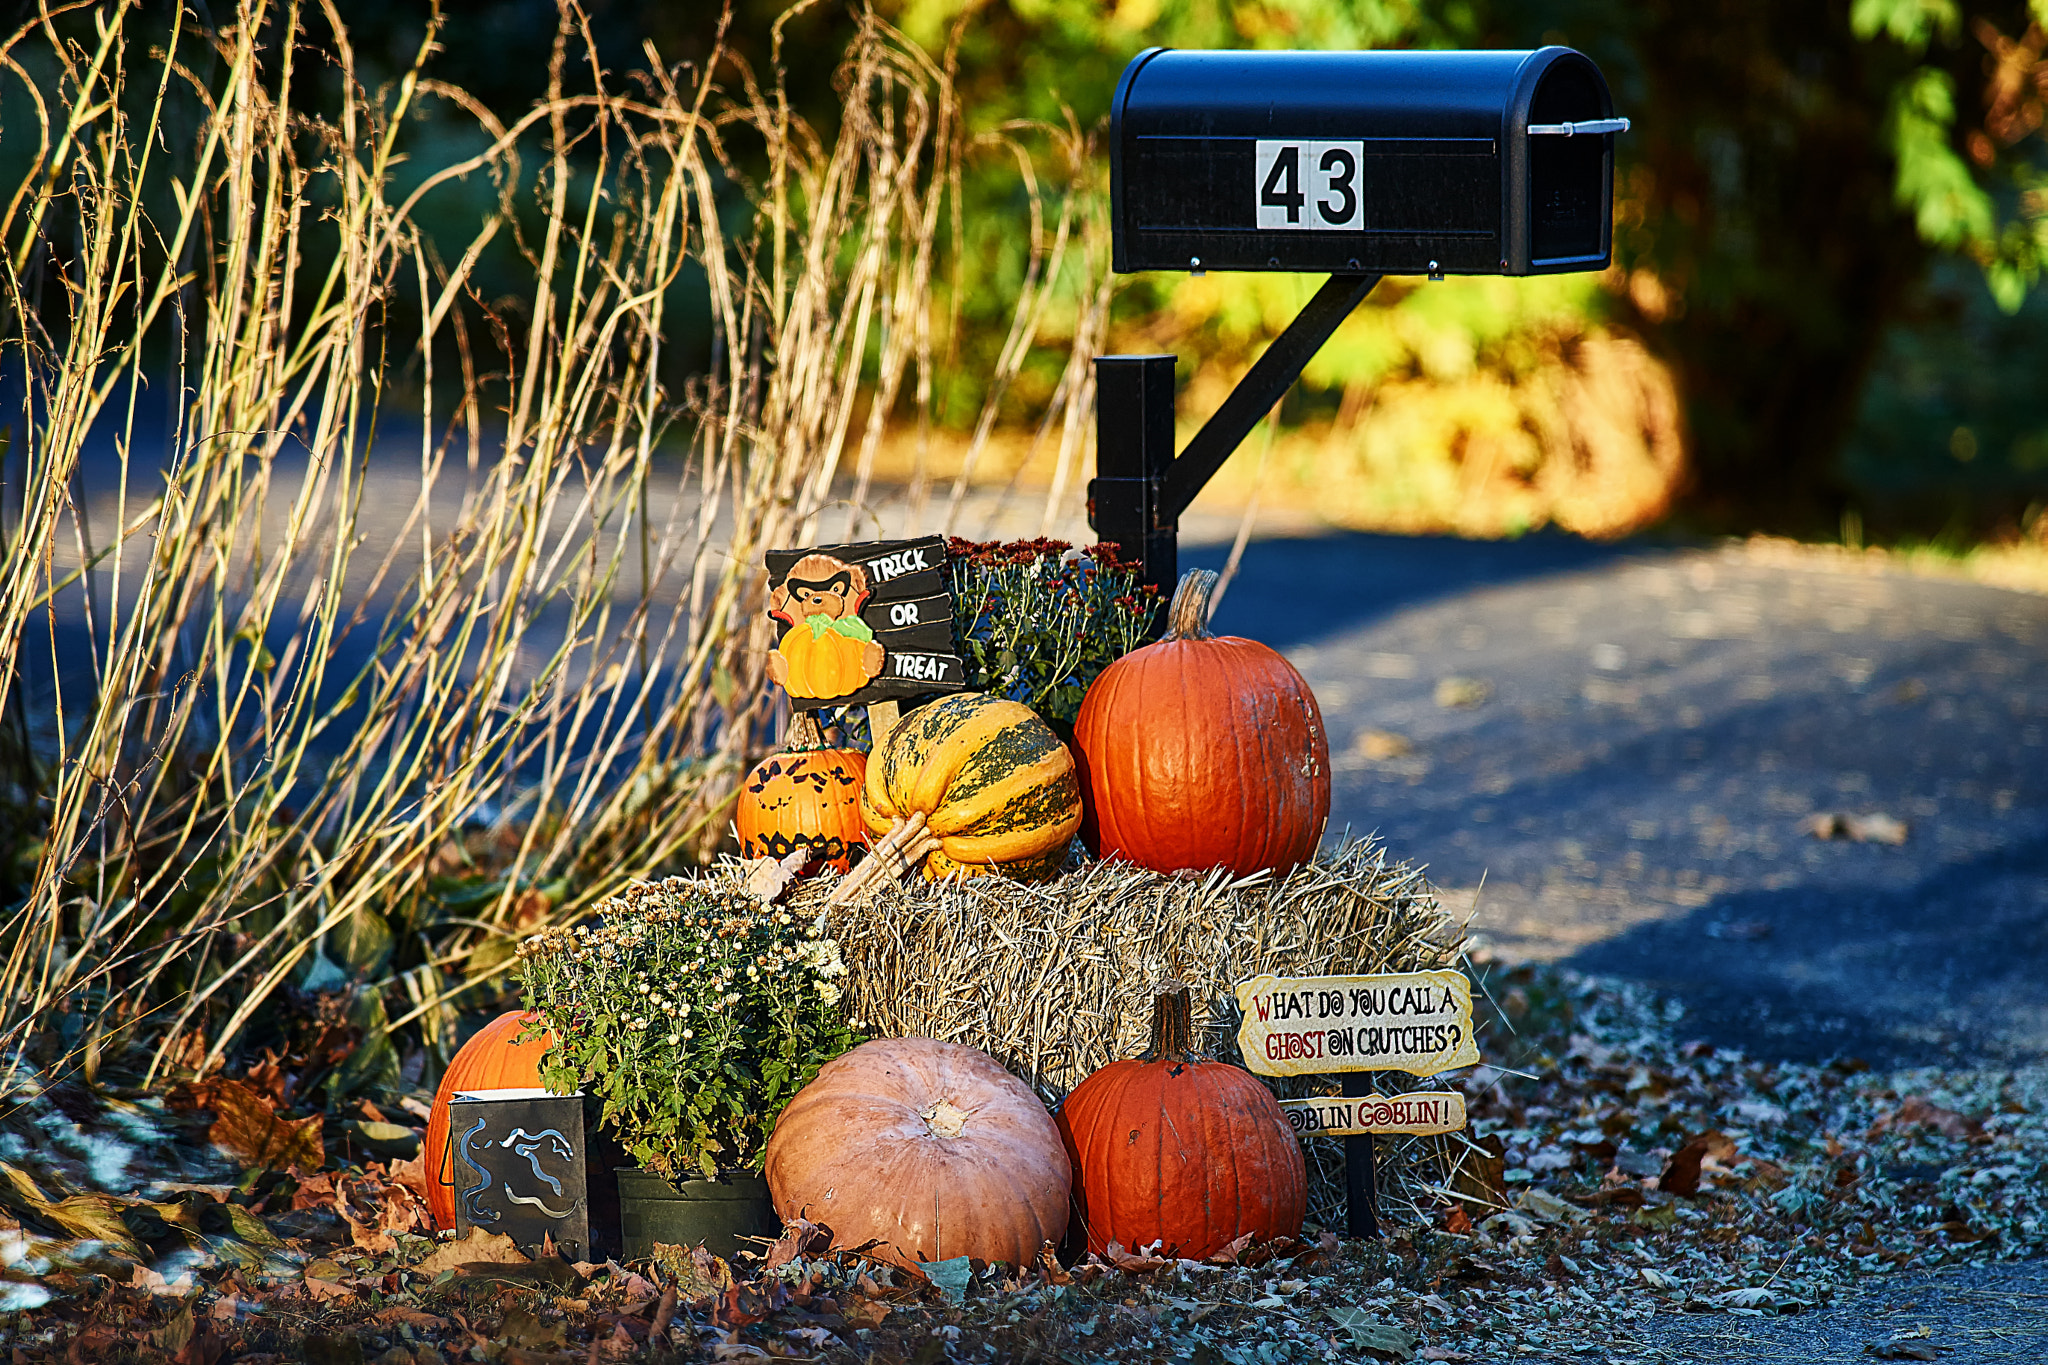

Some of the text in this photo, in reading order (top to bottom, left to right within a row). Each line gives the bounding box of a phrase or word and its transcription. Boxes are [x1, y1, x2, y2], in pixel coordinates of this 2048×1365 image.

[1260, 146, 1357, 225] 43
[867, 549, 929, 582] TRICK
[890, 603, 919, 625] OR
[894, 654, 948, 681] TREAT
[1252, 987, 1458, 1022] WHAT DO YOU CALL A
[1265, 1024, 1461, 1060] GHOST ON CRUTCHES?
[1284, 1105, 1352, 1132] OBLIN
